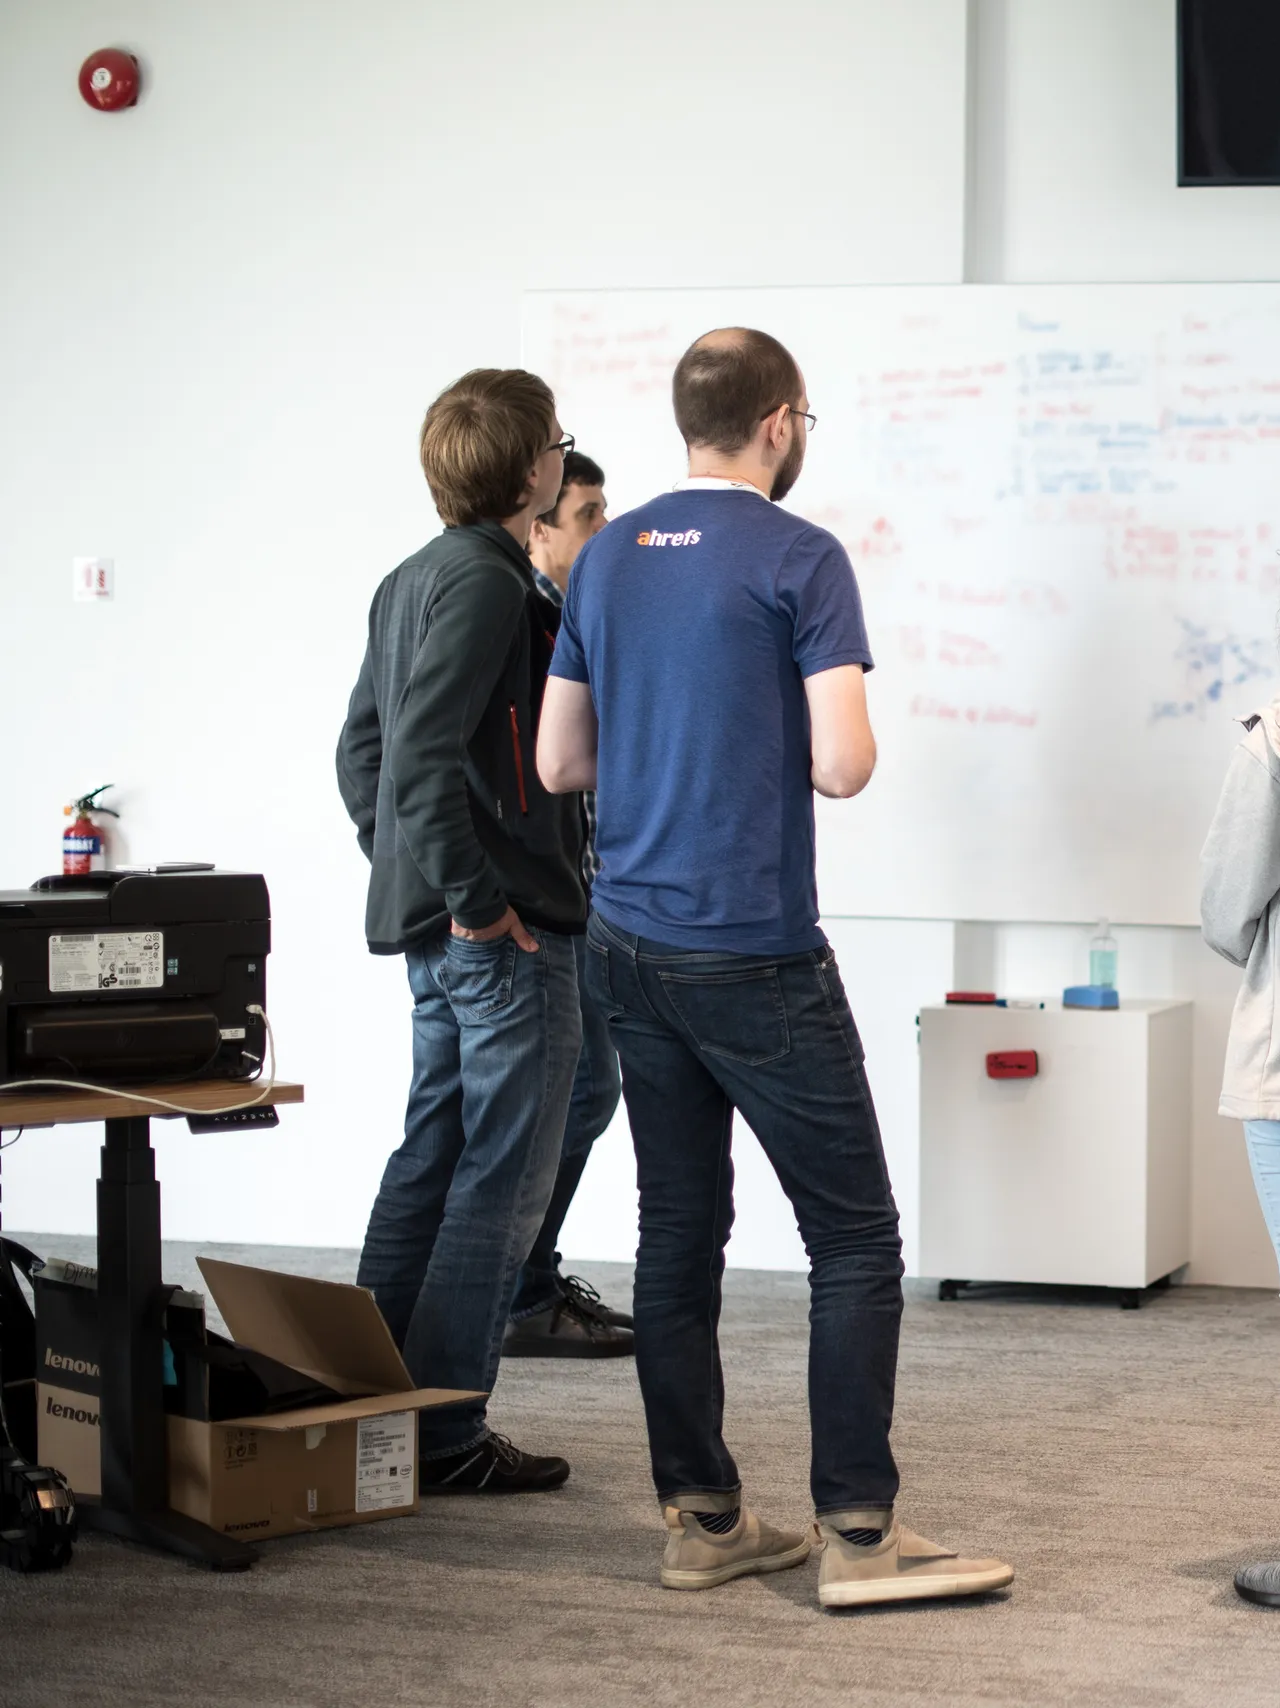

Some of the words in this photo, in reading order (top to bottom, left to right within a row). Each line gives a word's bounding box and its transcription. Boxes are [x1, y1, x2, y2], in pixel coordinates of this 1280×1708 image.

[636, 529, 702, 547] ahrefs
[44, 1348, 101, 1378] lenov
[46, 1397, 101, 1428] lenov
[223, 1520, 270, 1533] lenovo
